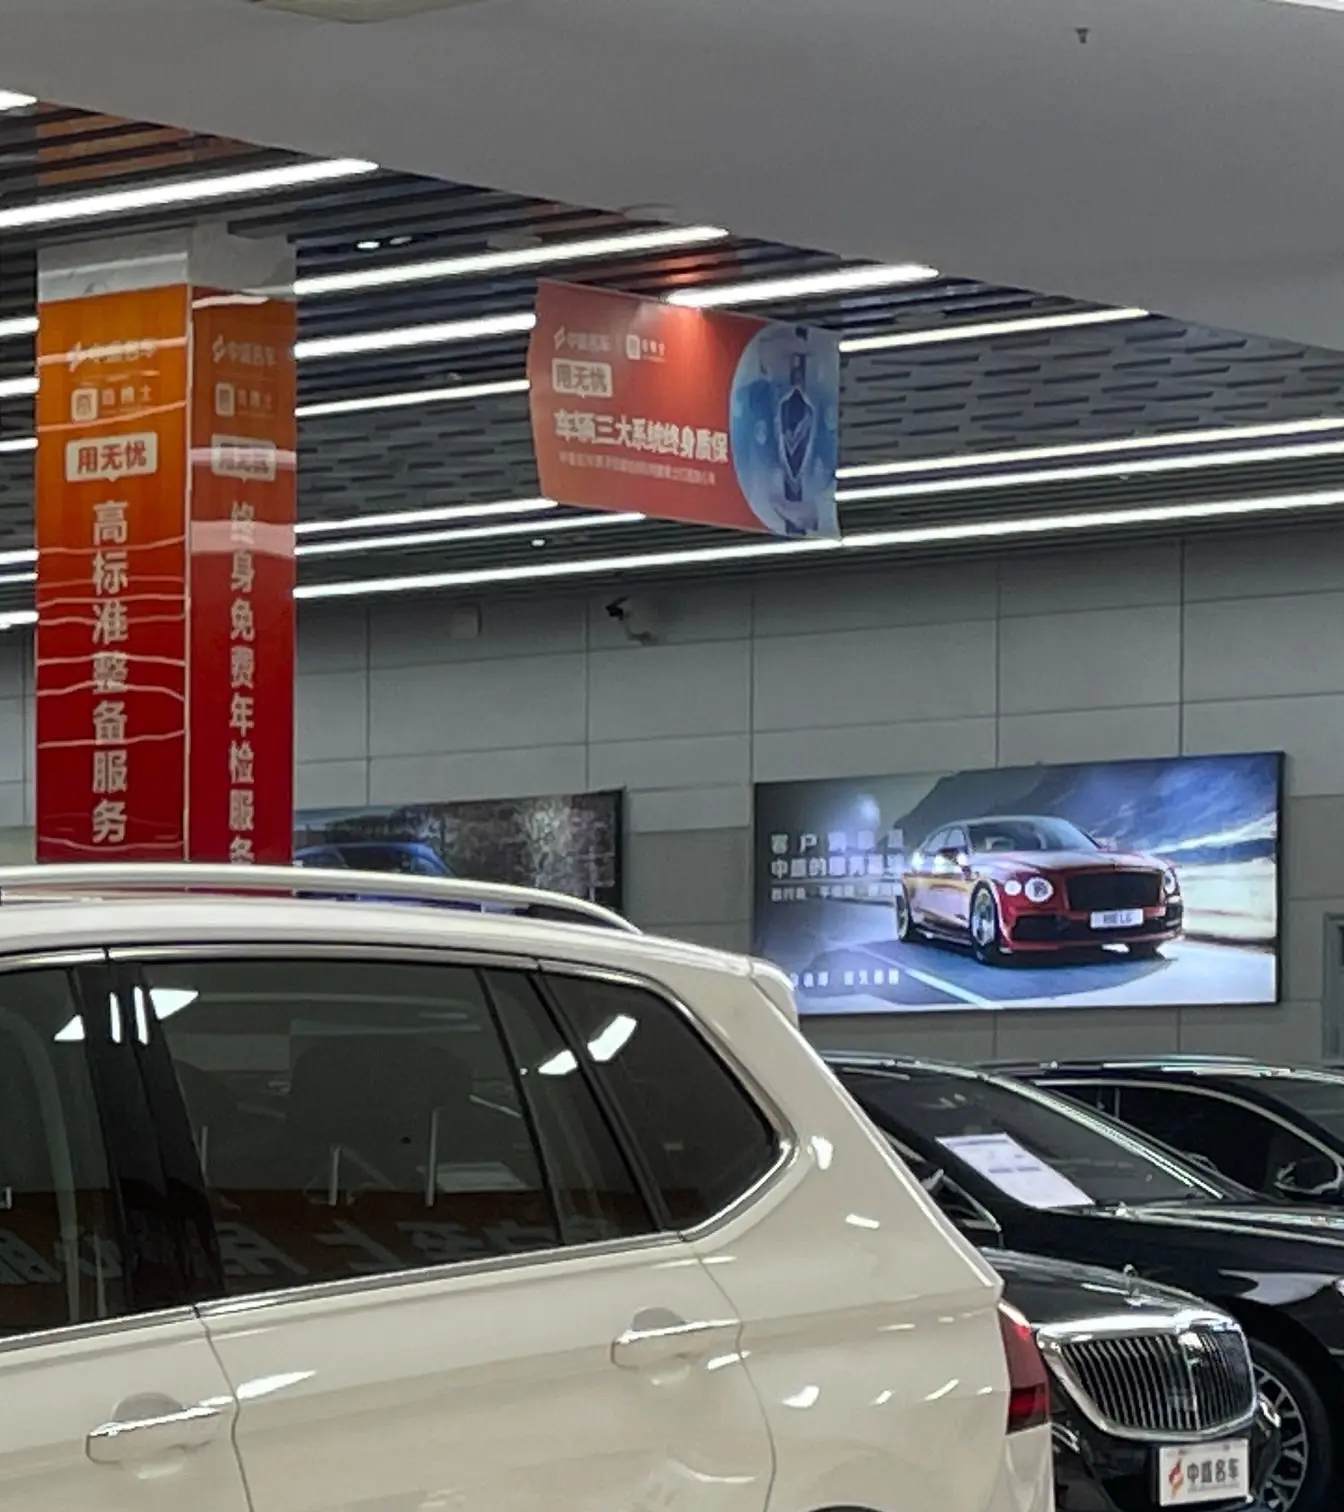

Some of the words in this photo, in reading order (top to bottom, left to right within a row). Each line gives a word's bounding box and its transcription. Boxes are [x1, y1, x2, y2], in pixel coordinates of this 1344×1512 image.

[77, 439, 148, 475] 用无忧
[91, 500, 128, 846] 高标准整备服务
